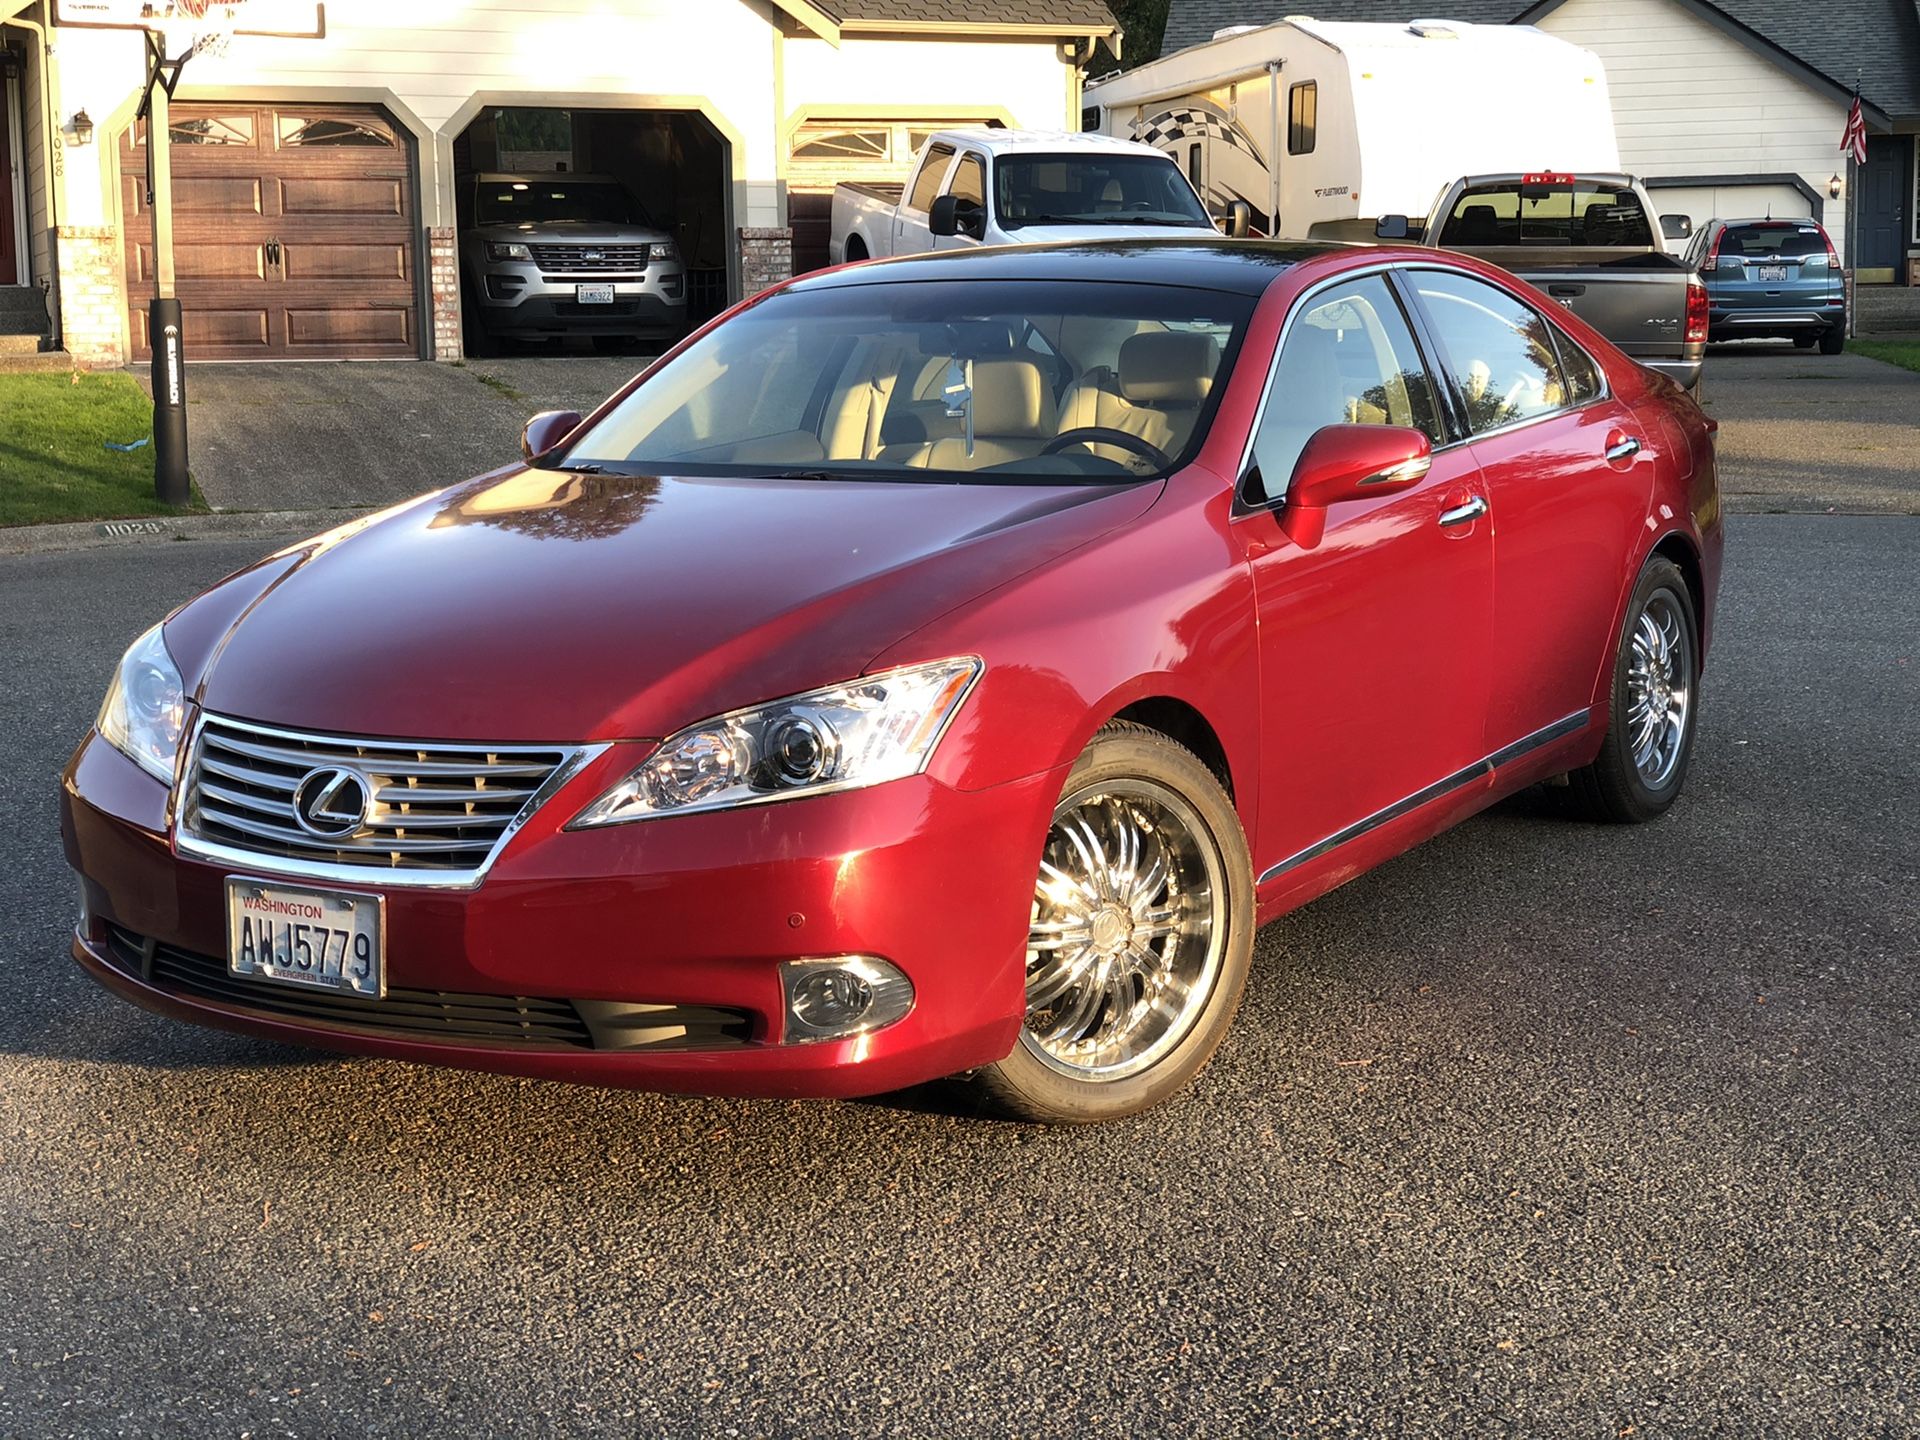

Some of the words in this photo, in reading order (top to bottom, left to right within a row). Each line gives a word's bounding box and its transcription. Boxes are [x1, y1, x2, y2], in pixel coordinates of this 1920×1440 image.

[53, 110, 63, 177] 11028
[1322, 186, 1349, 196] FLEETWOOD
[167, 337, 179, 404] SILVERBACK
[104, 522, 160, 536] 11028
[242, 896, 322, 919] WASHINGTON
[241, 916, 371, 980] AWJ5779
[273, 968, 317, 982] EVERGREEN
[320, 976, 340, 985] STAT
